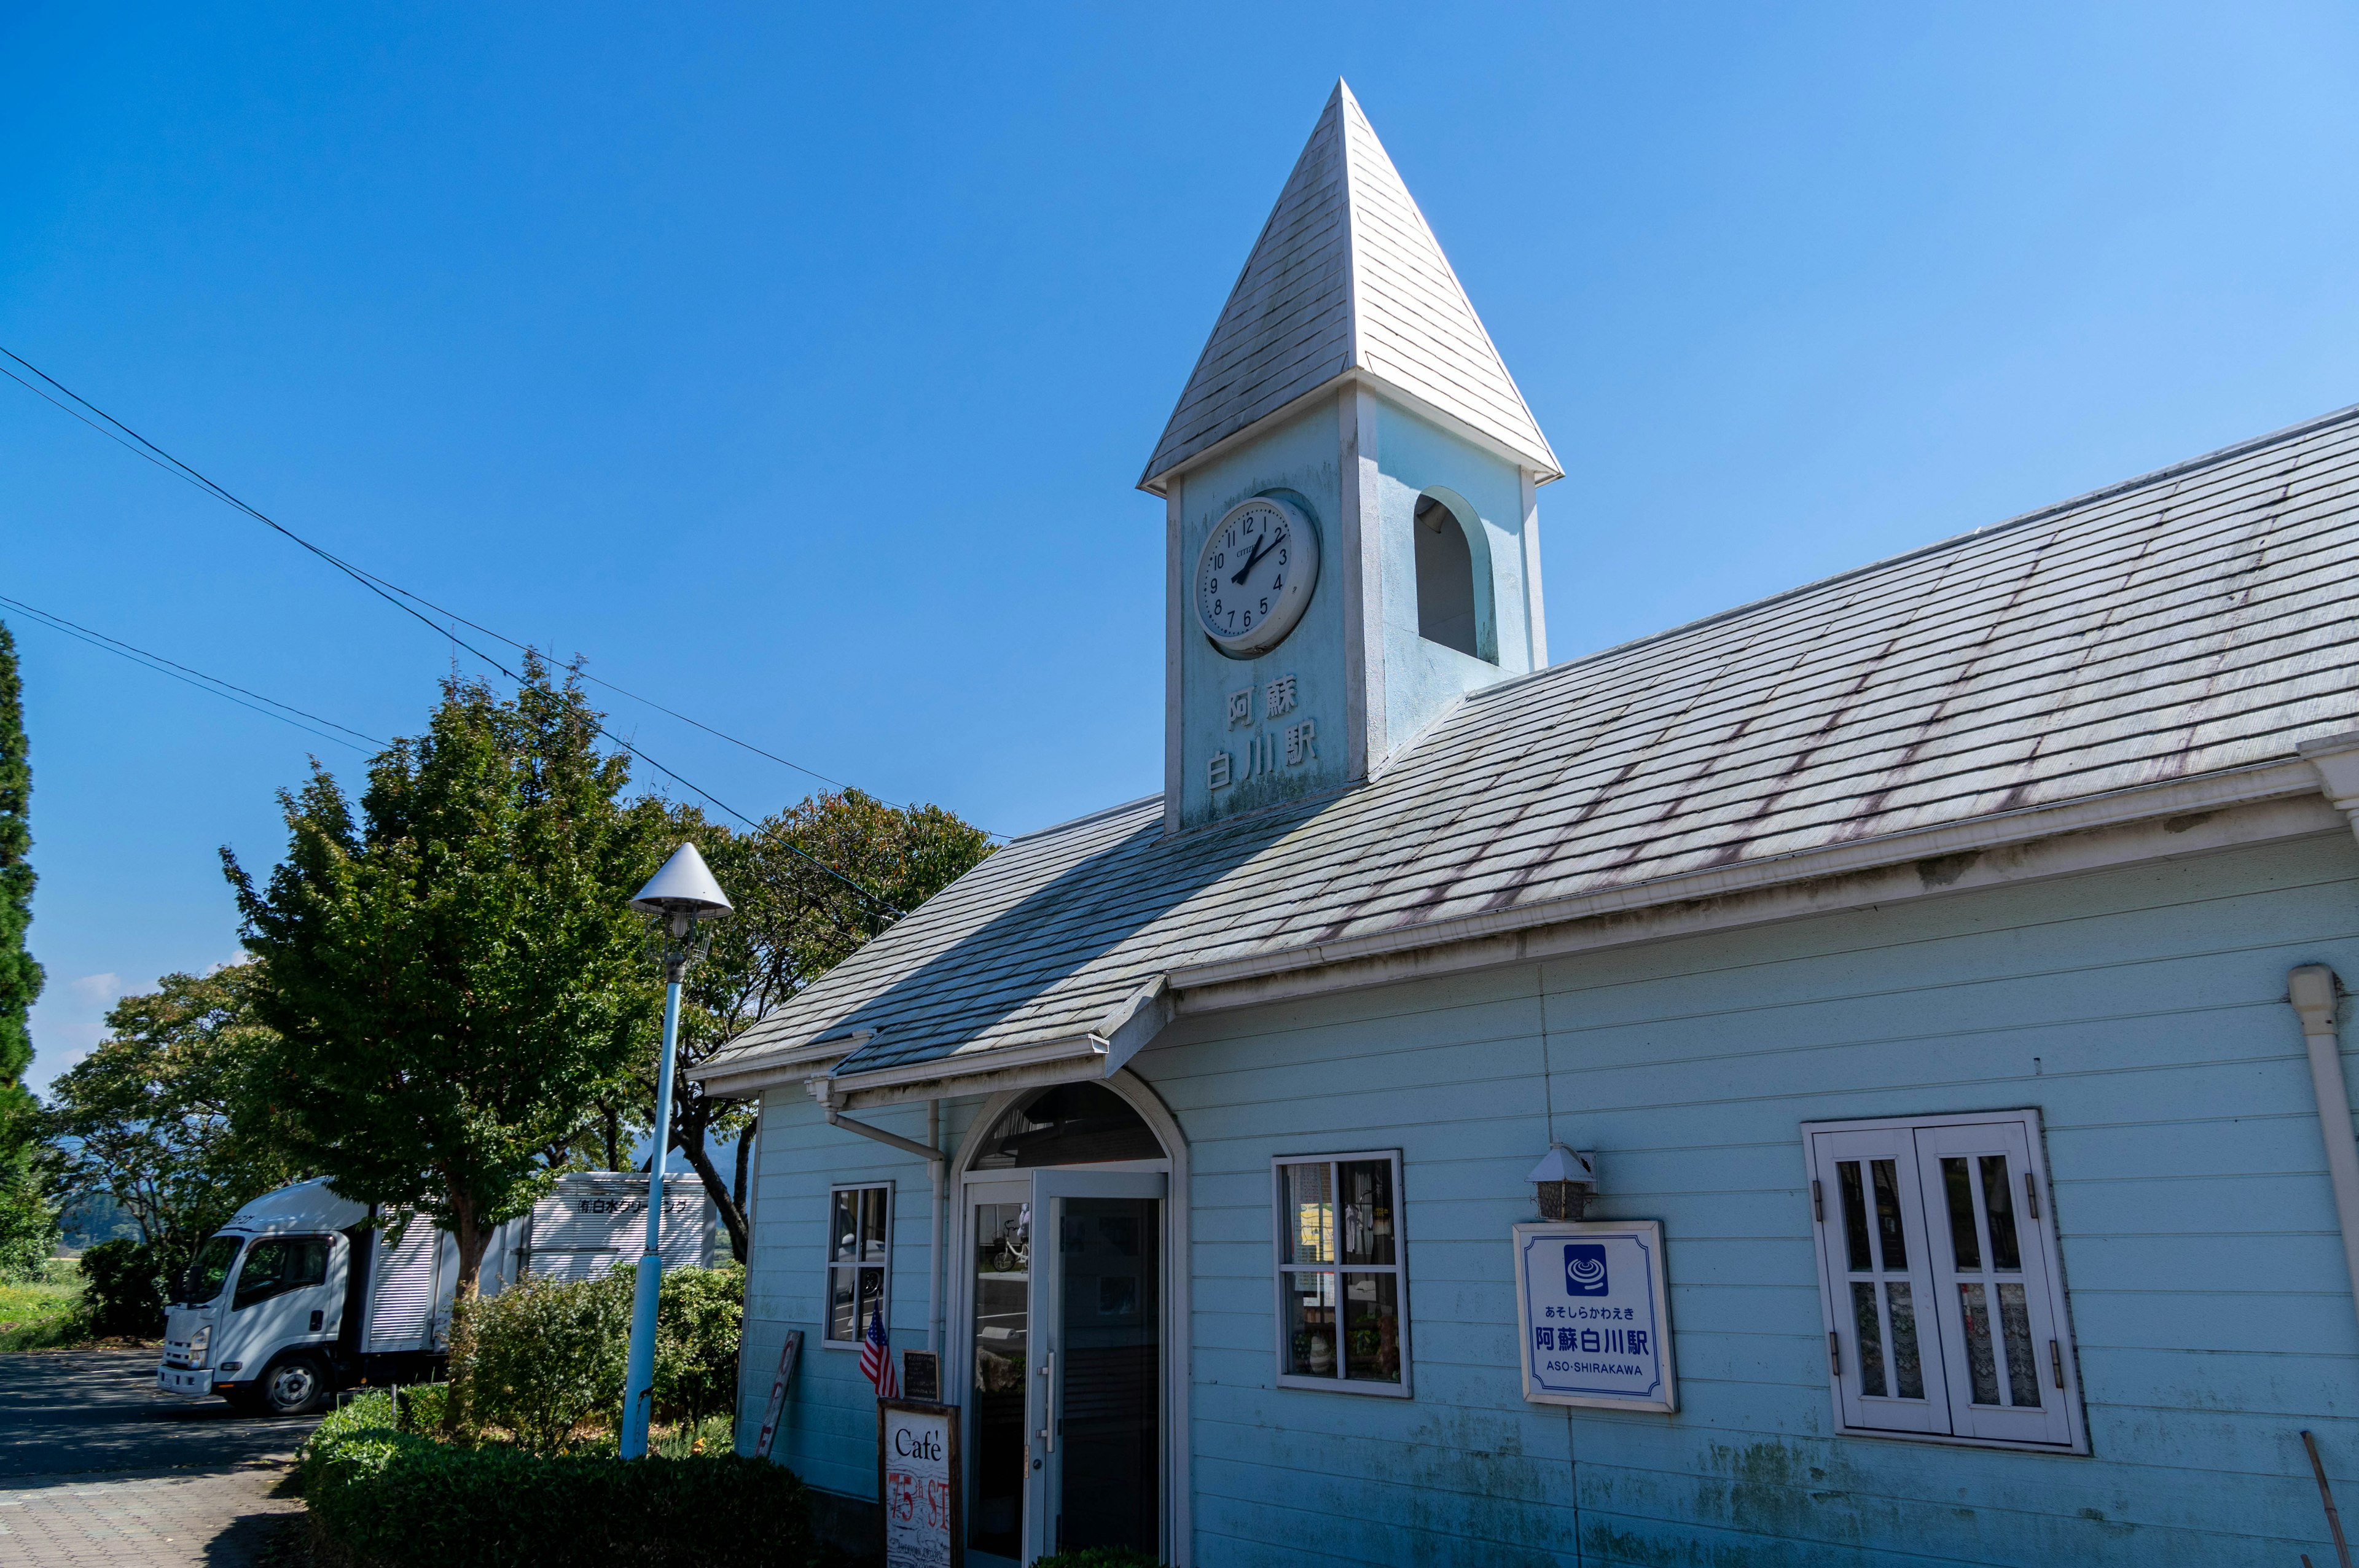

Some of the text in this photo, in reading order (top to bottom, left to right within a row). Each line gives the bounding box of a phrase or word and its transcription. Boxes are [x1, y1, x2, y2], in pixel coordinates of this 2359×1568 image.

[1243, 517, 1254, 536] 12
[1264, 516, 1267, 532] 1
[1227, 530, 1235, 548] 11
[1275, 527, 1283, 543] 2
[1214, 553, 1224, 571] 10
[1278, 548, 1287, 565] 3
[1210, 578, 1218, 594] 9
[1273, 574, 1283, 590] 4
[1214, 599, 1222, 615] 8
[1260, 597, 1268, 614] 5
[1227, 610, 1235, 628] 7
[1243, 610, 1251, 627] 6
[1228, 675, 1297, 731] 阿蘇
[1208, 719, 1316, 790] 白川駅
[1545, 1306, 1634, 1320] あそしらかわえき
[1536, 1327, 1649, 1355] 阿蘇白川駅
[888, 1473, 949, 1530] 75th ST
